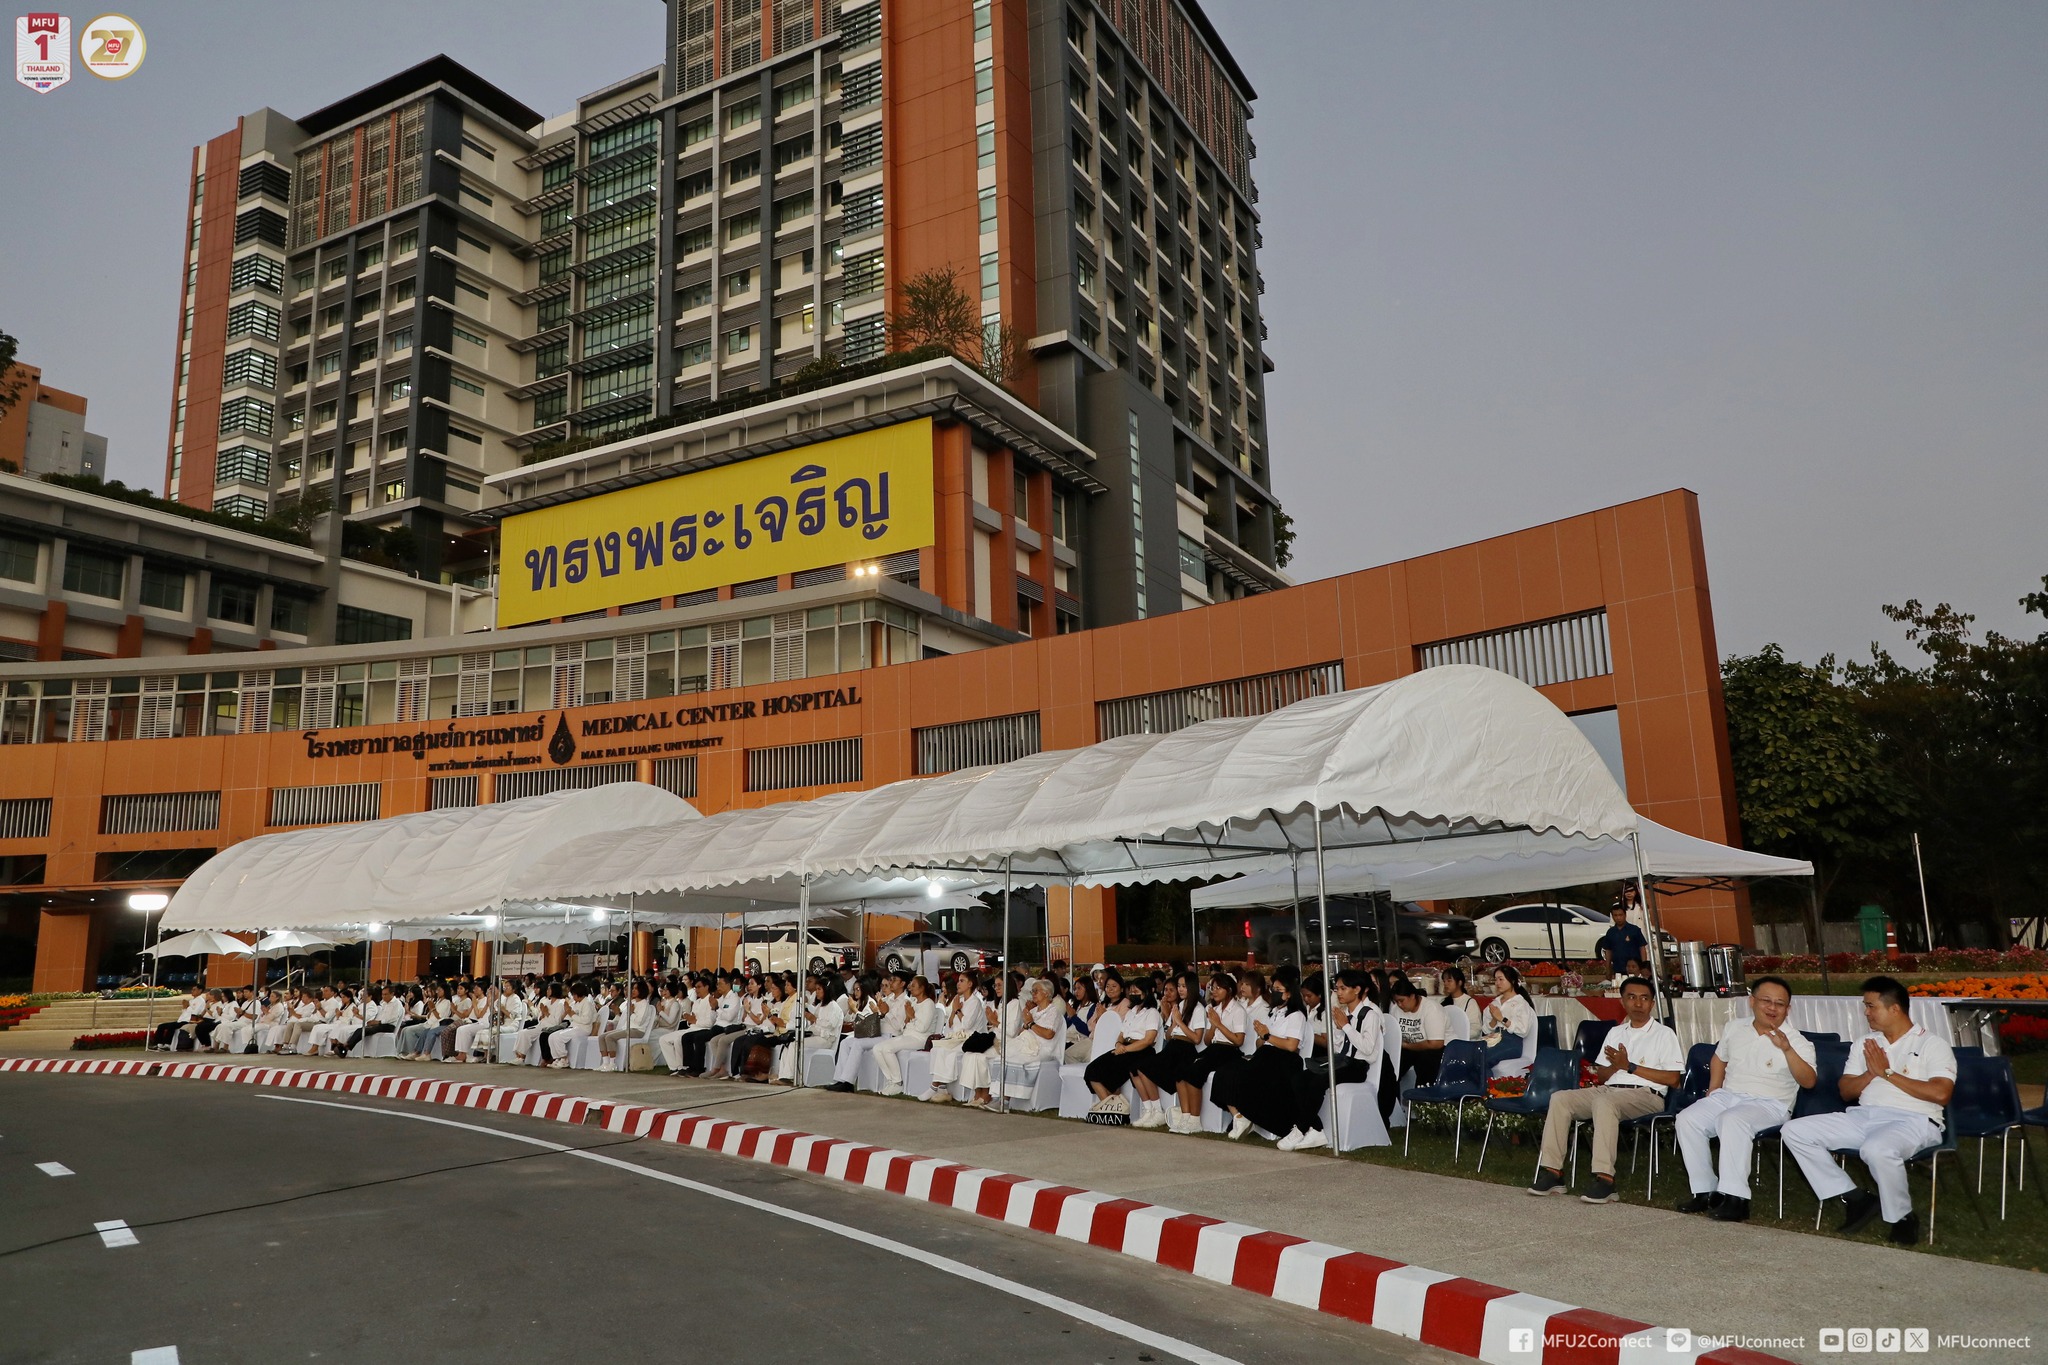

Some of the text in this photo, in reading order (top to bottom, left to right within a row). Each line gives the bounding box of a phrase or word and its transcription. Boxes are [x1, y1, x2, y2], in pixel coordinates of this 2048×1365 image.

[524, 464, 890, 592] ทรงพระเจริญ
[581, 686, 862, 737] MEDICAL CENTER HOSPITAL
[303, 715, 546, 760] โรงพยาบาลศูนย์การแพทย์
[581, 749, 603, 760] MAE
[628, 743, 661, 756] LUANG
[664, 736, 724, 752] UNIVERSITY
